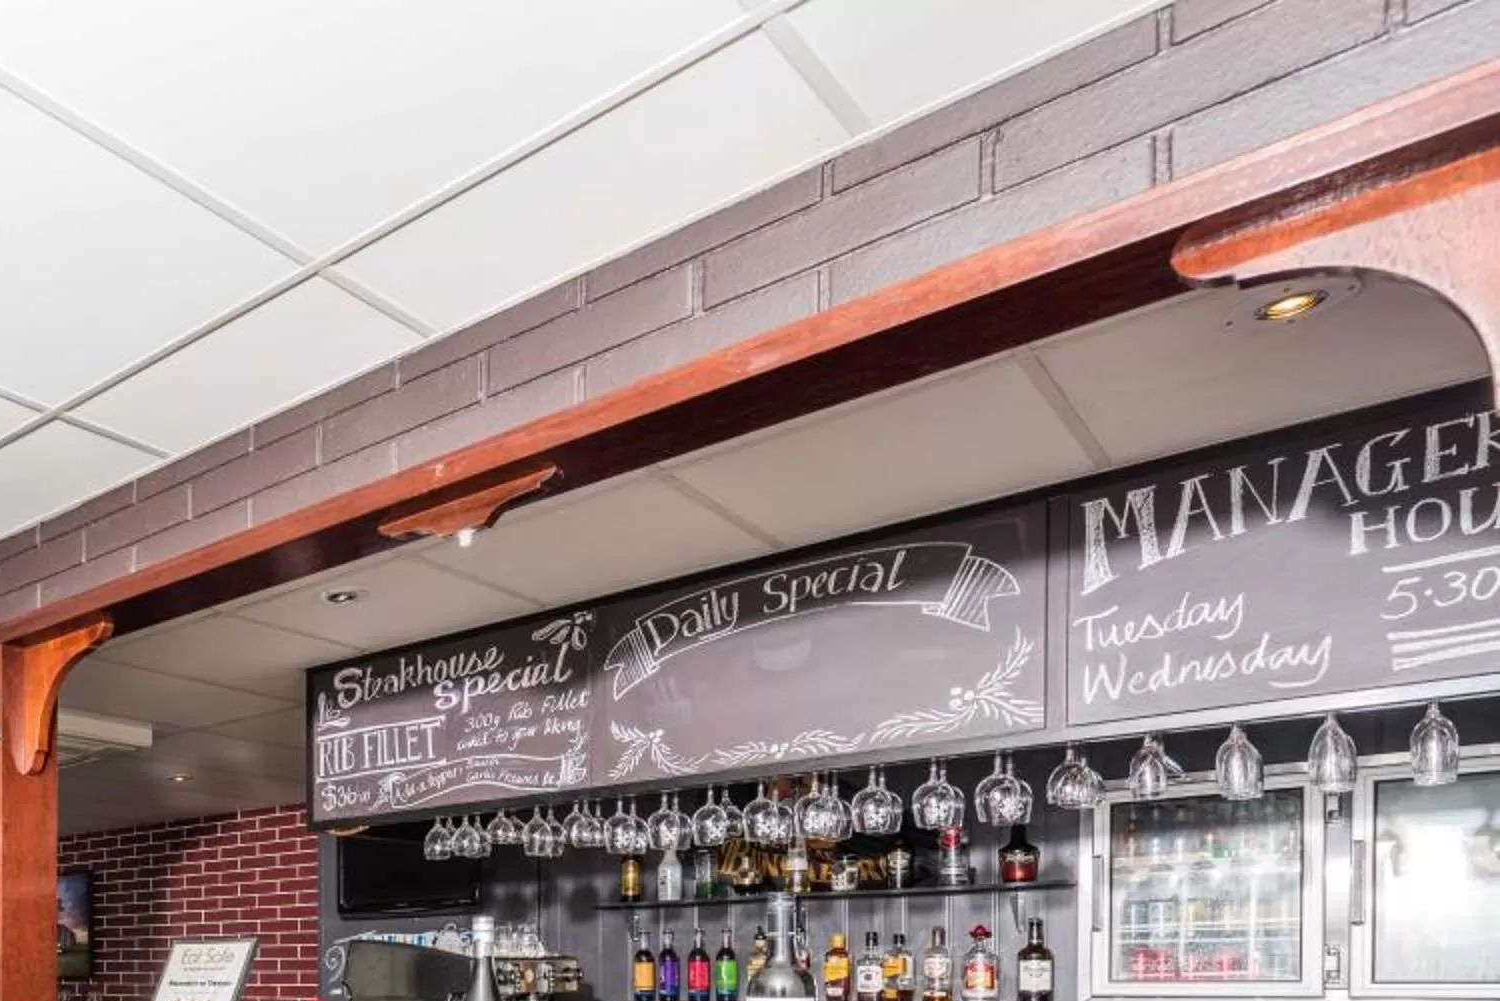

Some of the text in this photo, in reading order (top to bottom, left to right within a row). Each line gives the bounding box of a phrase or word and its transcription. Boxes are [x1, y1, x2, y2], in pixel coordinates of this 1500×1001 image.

[1349, 481, 1500, 556] HOU
[642, 550, 907, 657] Daily Special
[1073, 591, 1245, 651] Tuesday
[333, 645, 504, 709] Steakhouse
[433, 642, 573, 714] Special
[541, 689, 590, 713] Fillet
[1083, 632, 1332, 704] Wednesday
[318, 721, 441, 777] RIB FILLET
